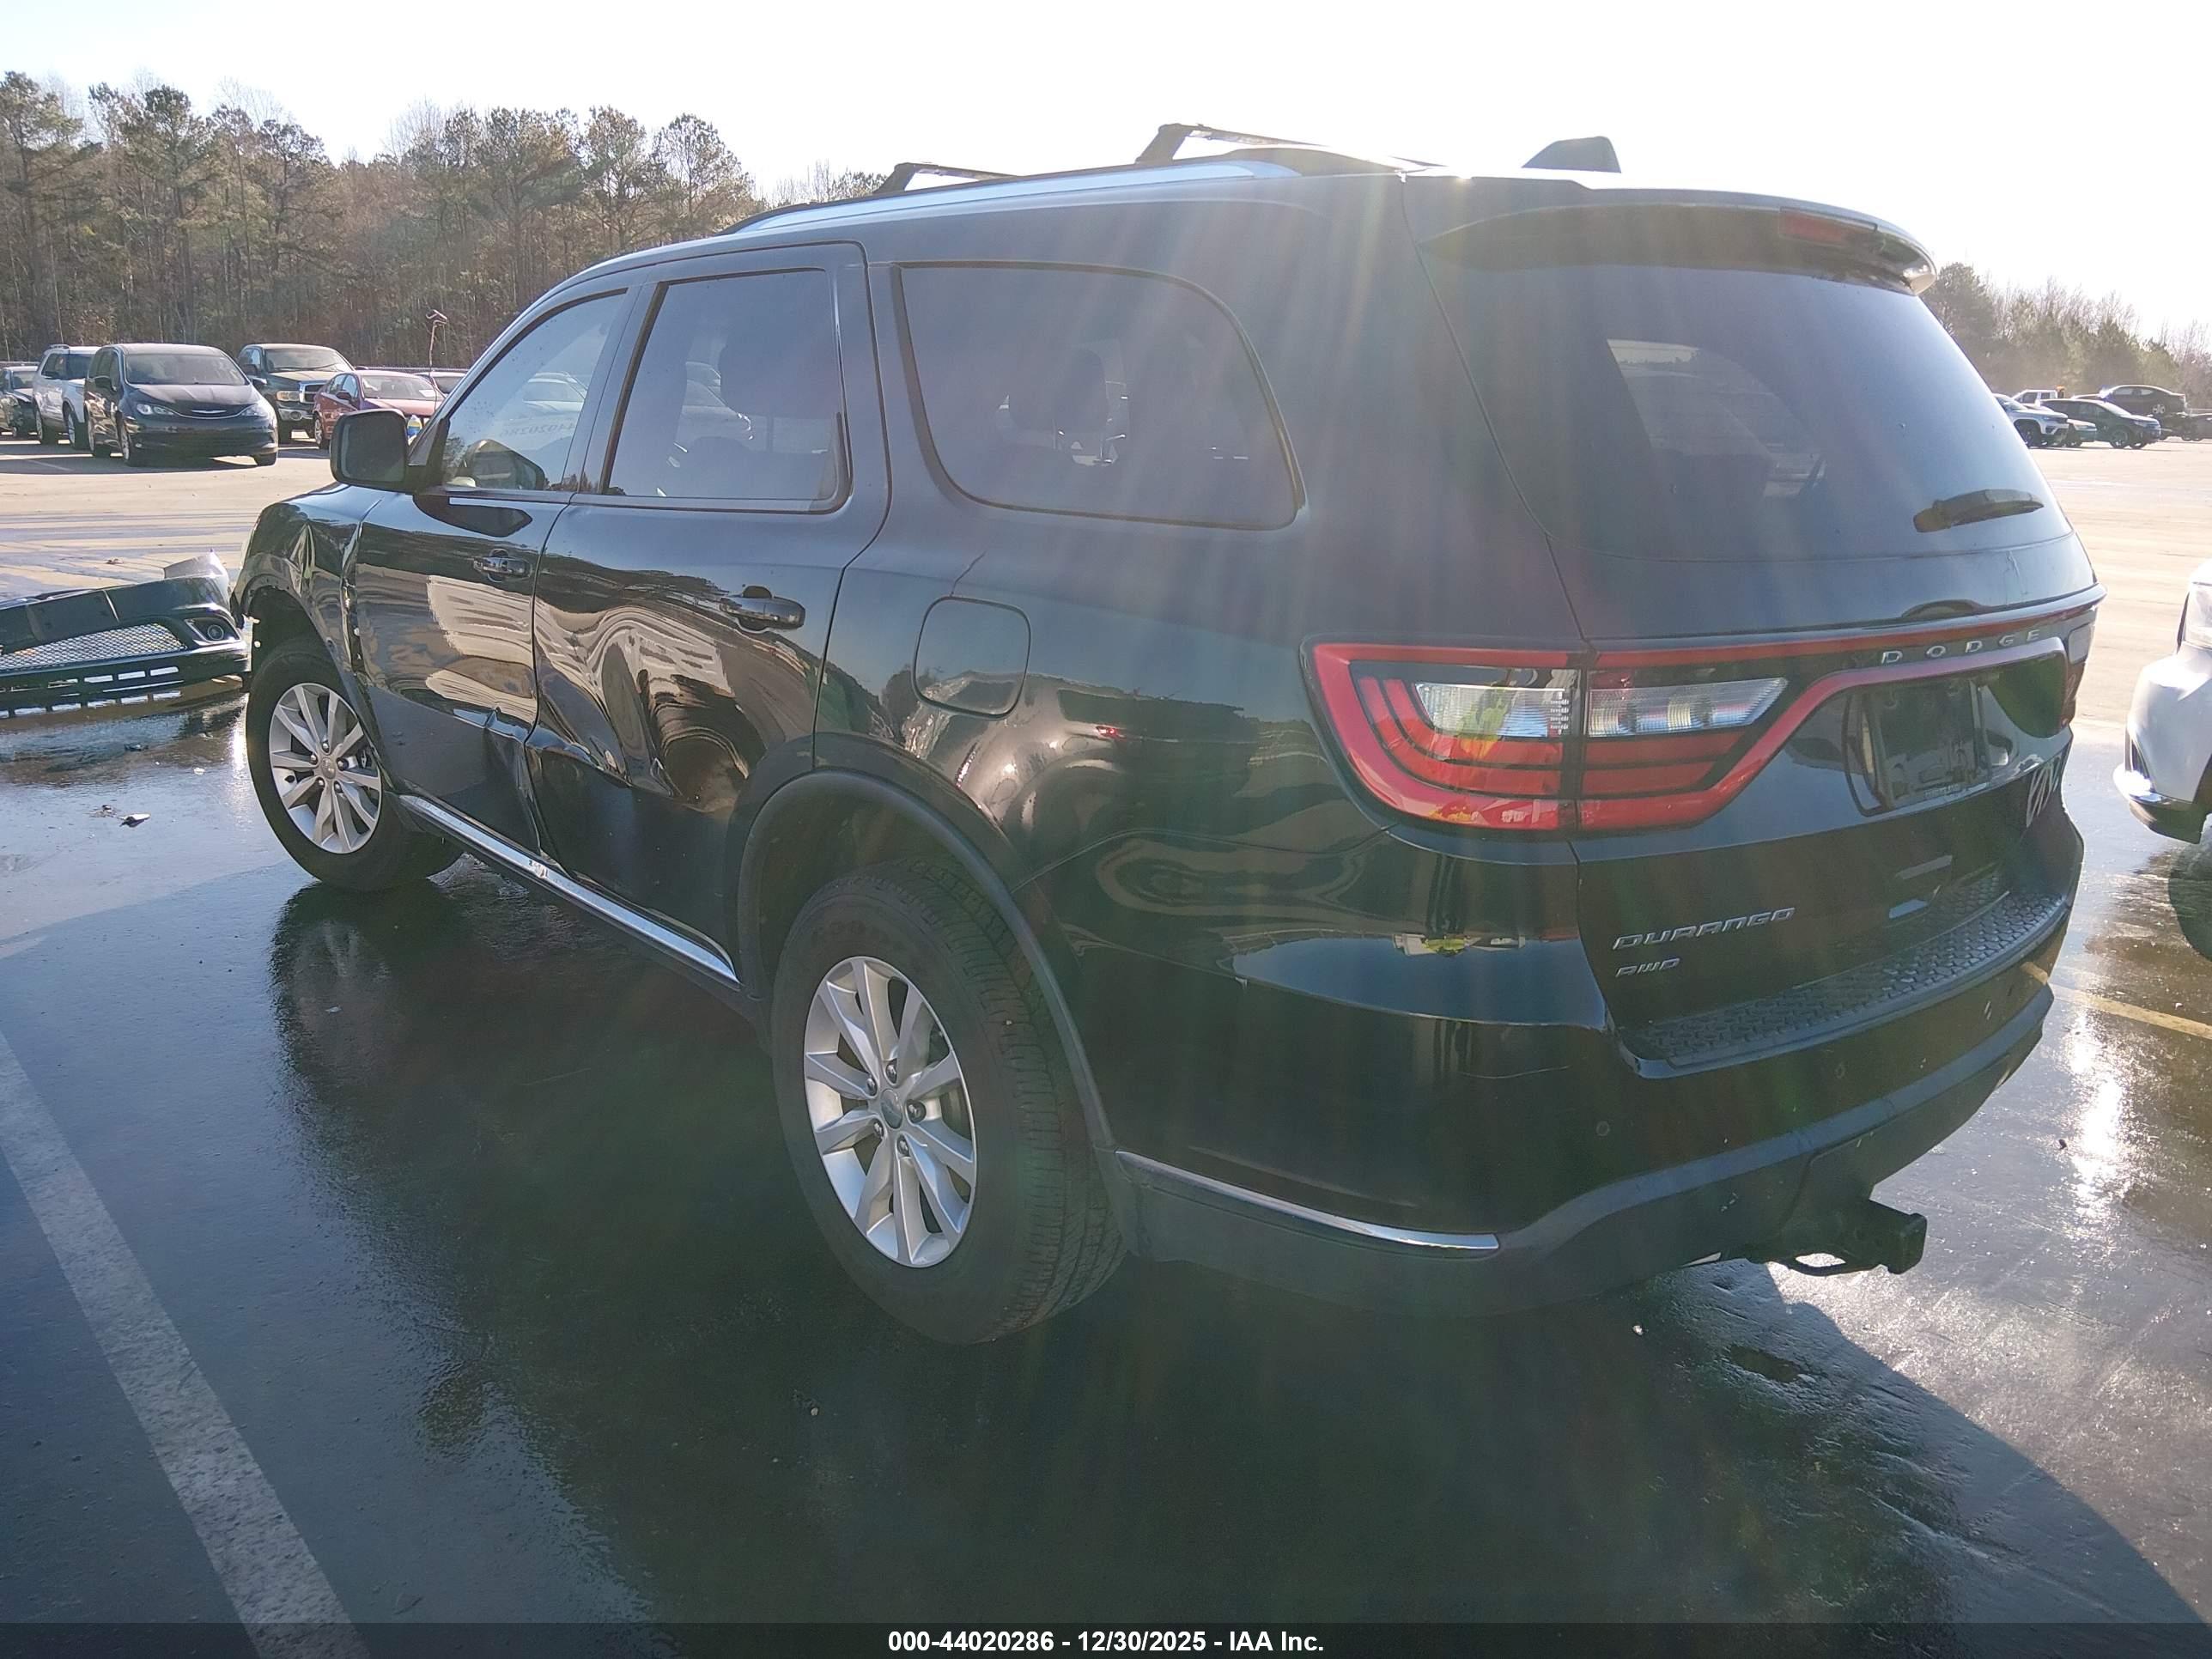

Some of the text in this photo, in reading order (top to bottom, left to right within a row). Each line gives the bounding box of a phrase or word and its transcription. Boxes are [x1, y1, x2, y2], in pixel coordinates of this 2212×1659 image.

[1881, 629, 2040, 665] DODGE
[1613, 907, 1796, 951] DURANGO
[1615, 957, 1680, 977] AWD
